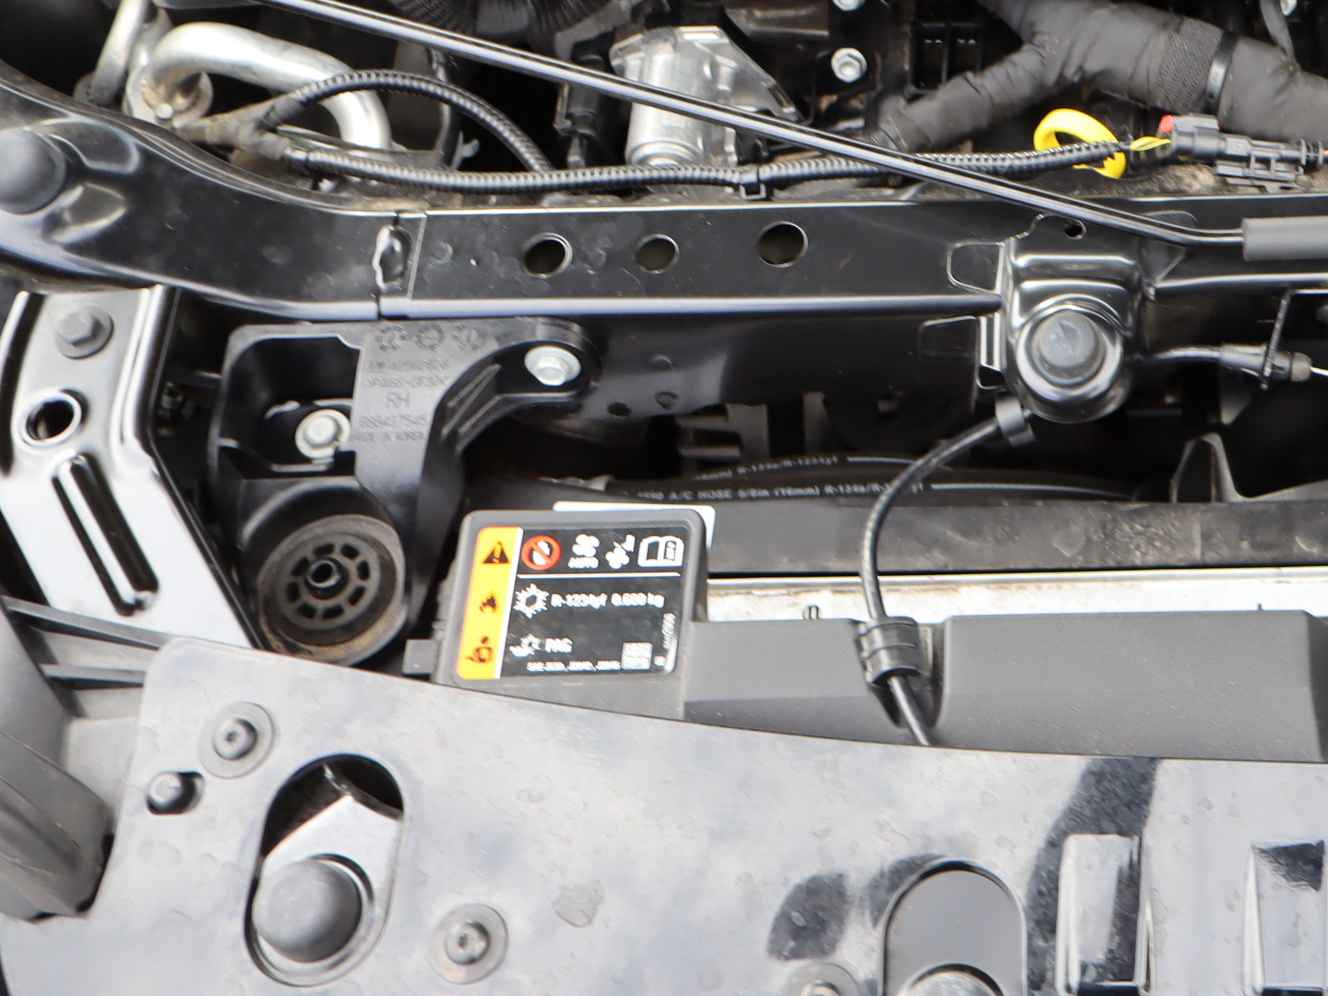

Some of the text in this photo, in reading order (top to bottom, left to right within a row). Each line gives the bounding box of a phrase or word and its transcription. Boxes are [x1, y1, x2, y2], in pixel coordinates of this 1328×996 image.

[668, 490, 693, 501] A/C
[698, 488, 732, 500] HOSE
[545, 637, 573, 653] PAG
